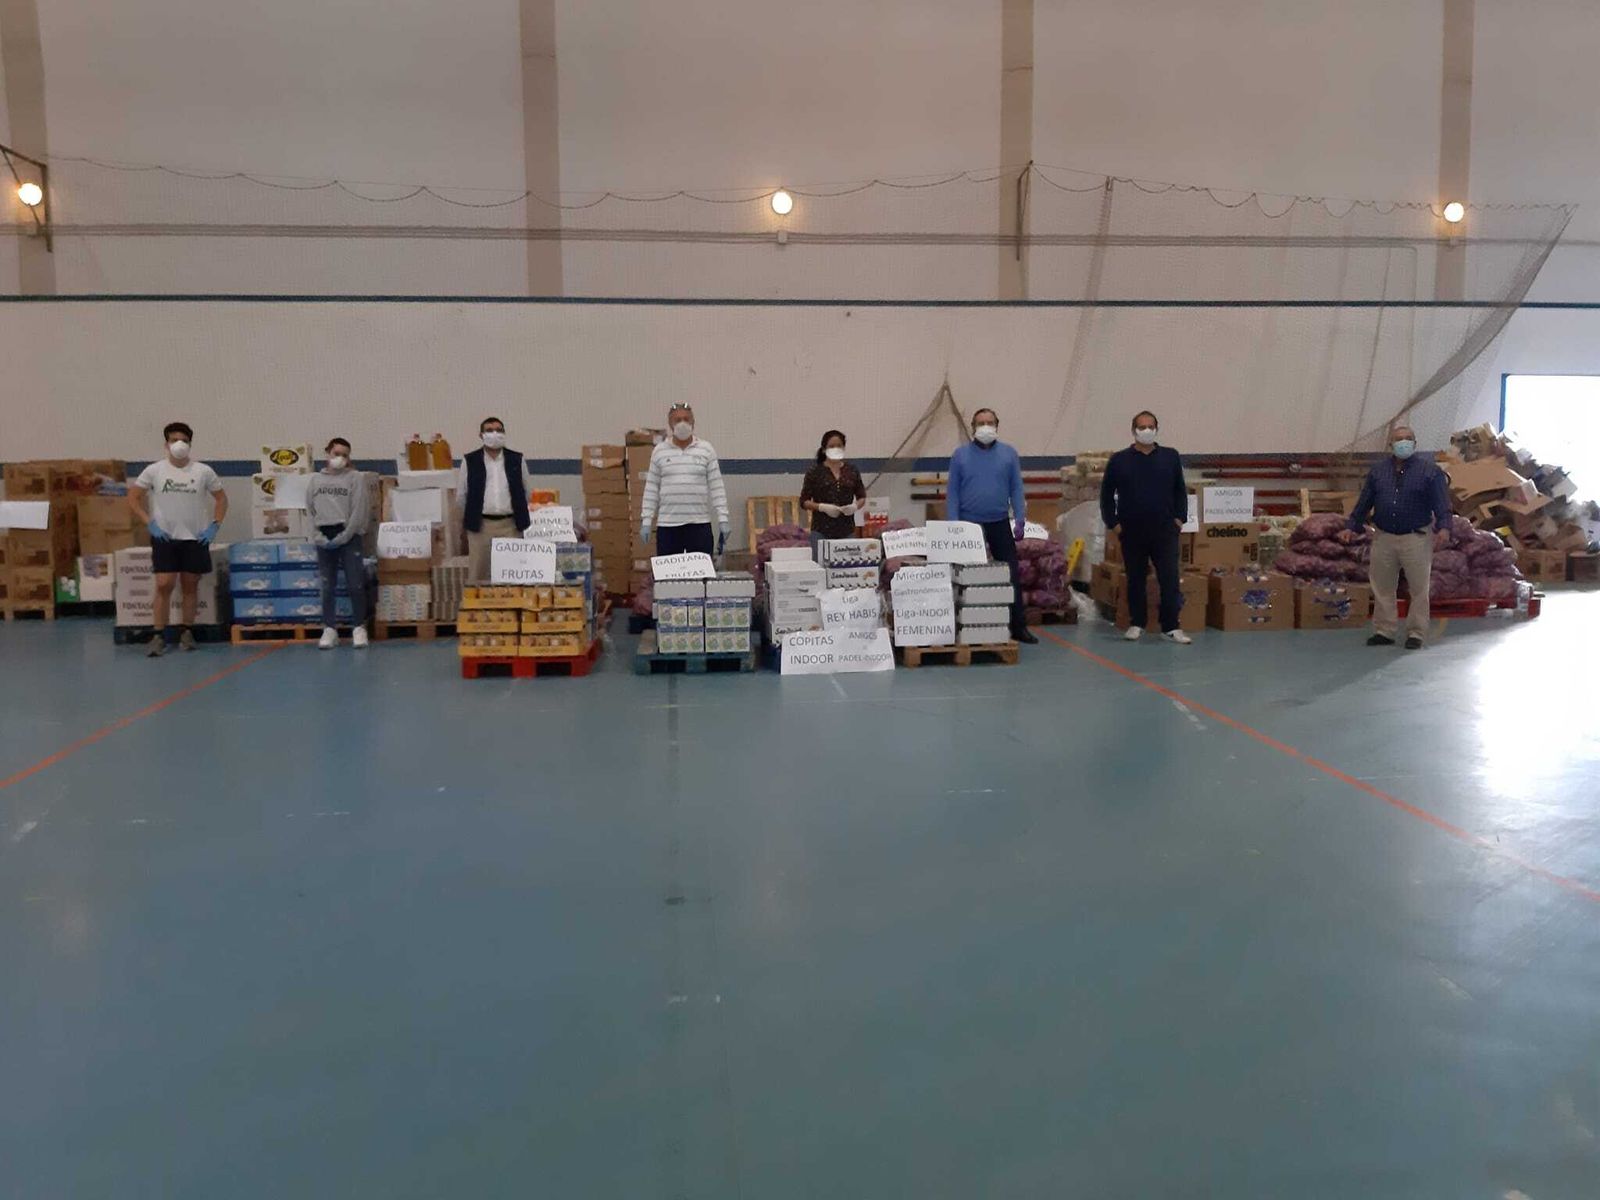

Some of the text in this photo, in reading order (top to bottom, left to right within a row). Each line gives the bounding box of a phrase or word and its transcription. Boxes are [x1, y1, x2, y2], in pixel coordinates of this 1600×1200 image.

[495, 542, 553, 554] GADITANA
[931, 540, 982, 550] REY HABIS
[655, 554, 709, 565] GADITANA
[501, 568, 544, 580] FRUTAS
[827, 608, 877, 623] REY HABIS
[848, 631, 878, 640] AMIGOS
[897, 625, 953, 636] FEMENINA
[789, 635, 834, 647] COPITAS
[790, 653, 835, 665] INDOOR
